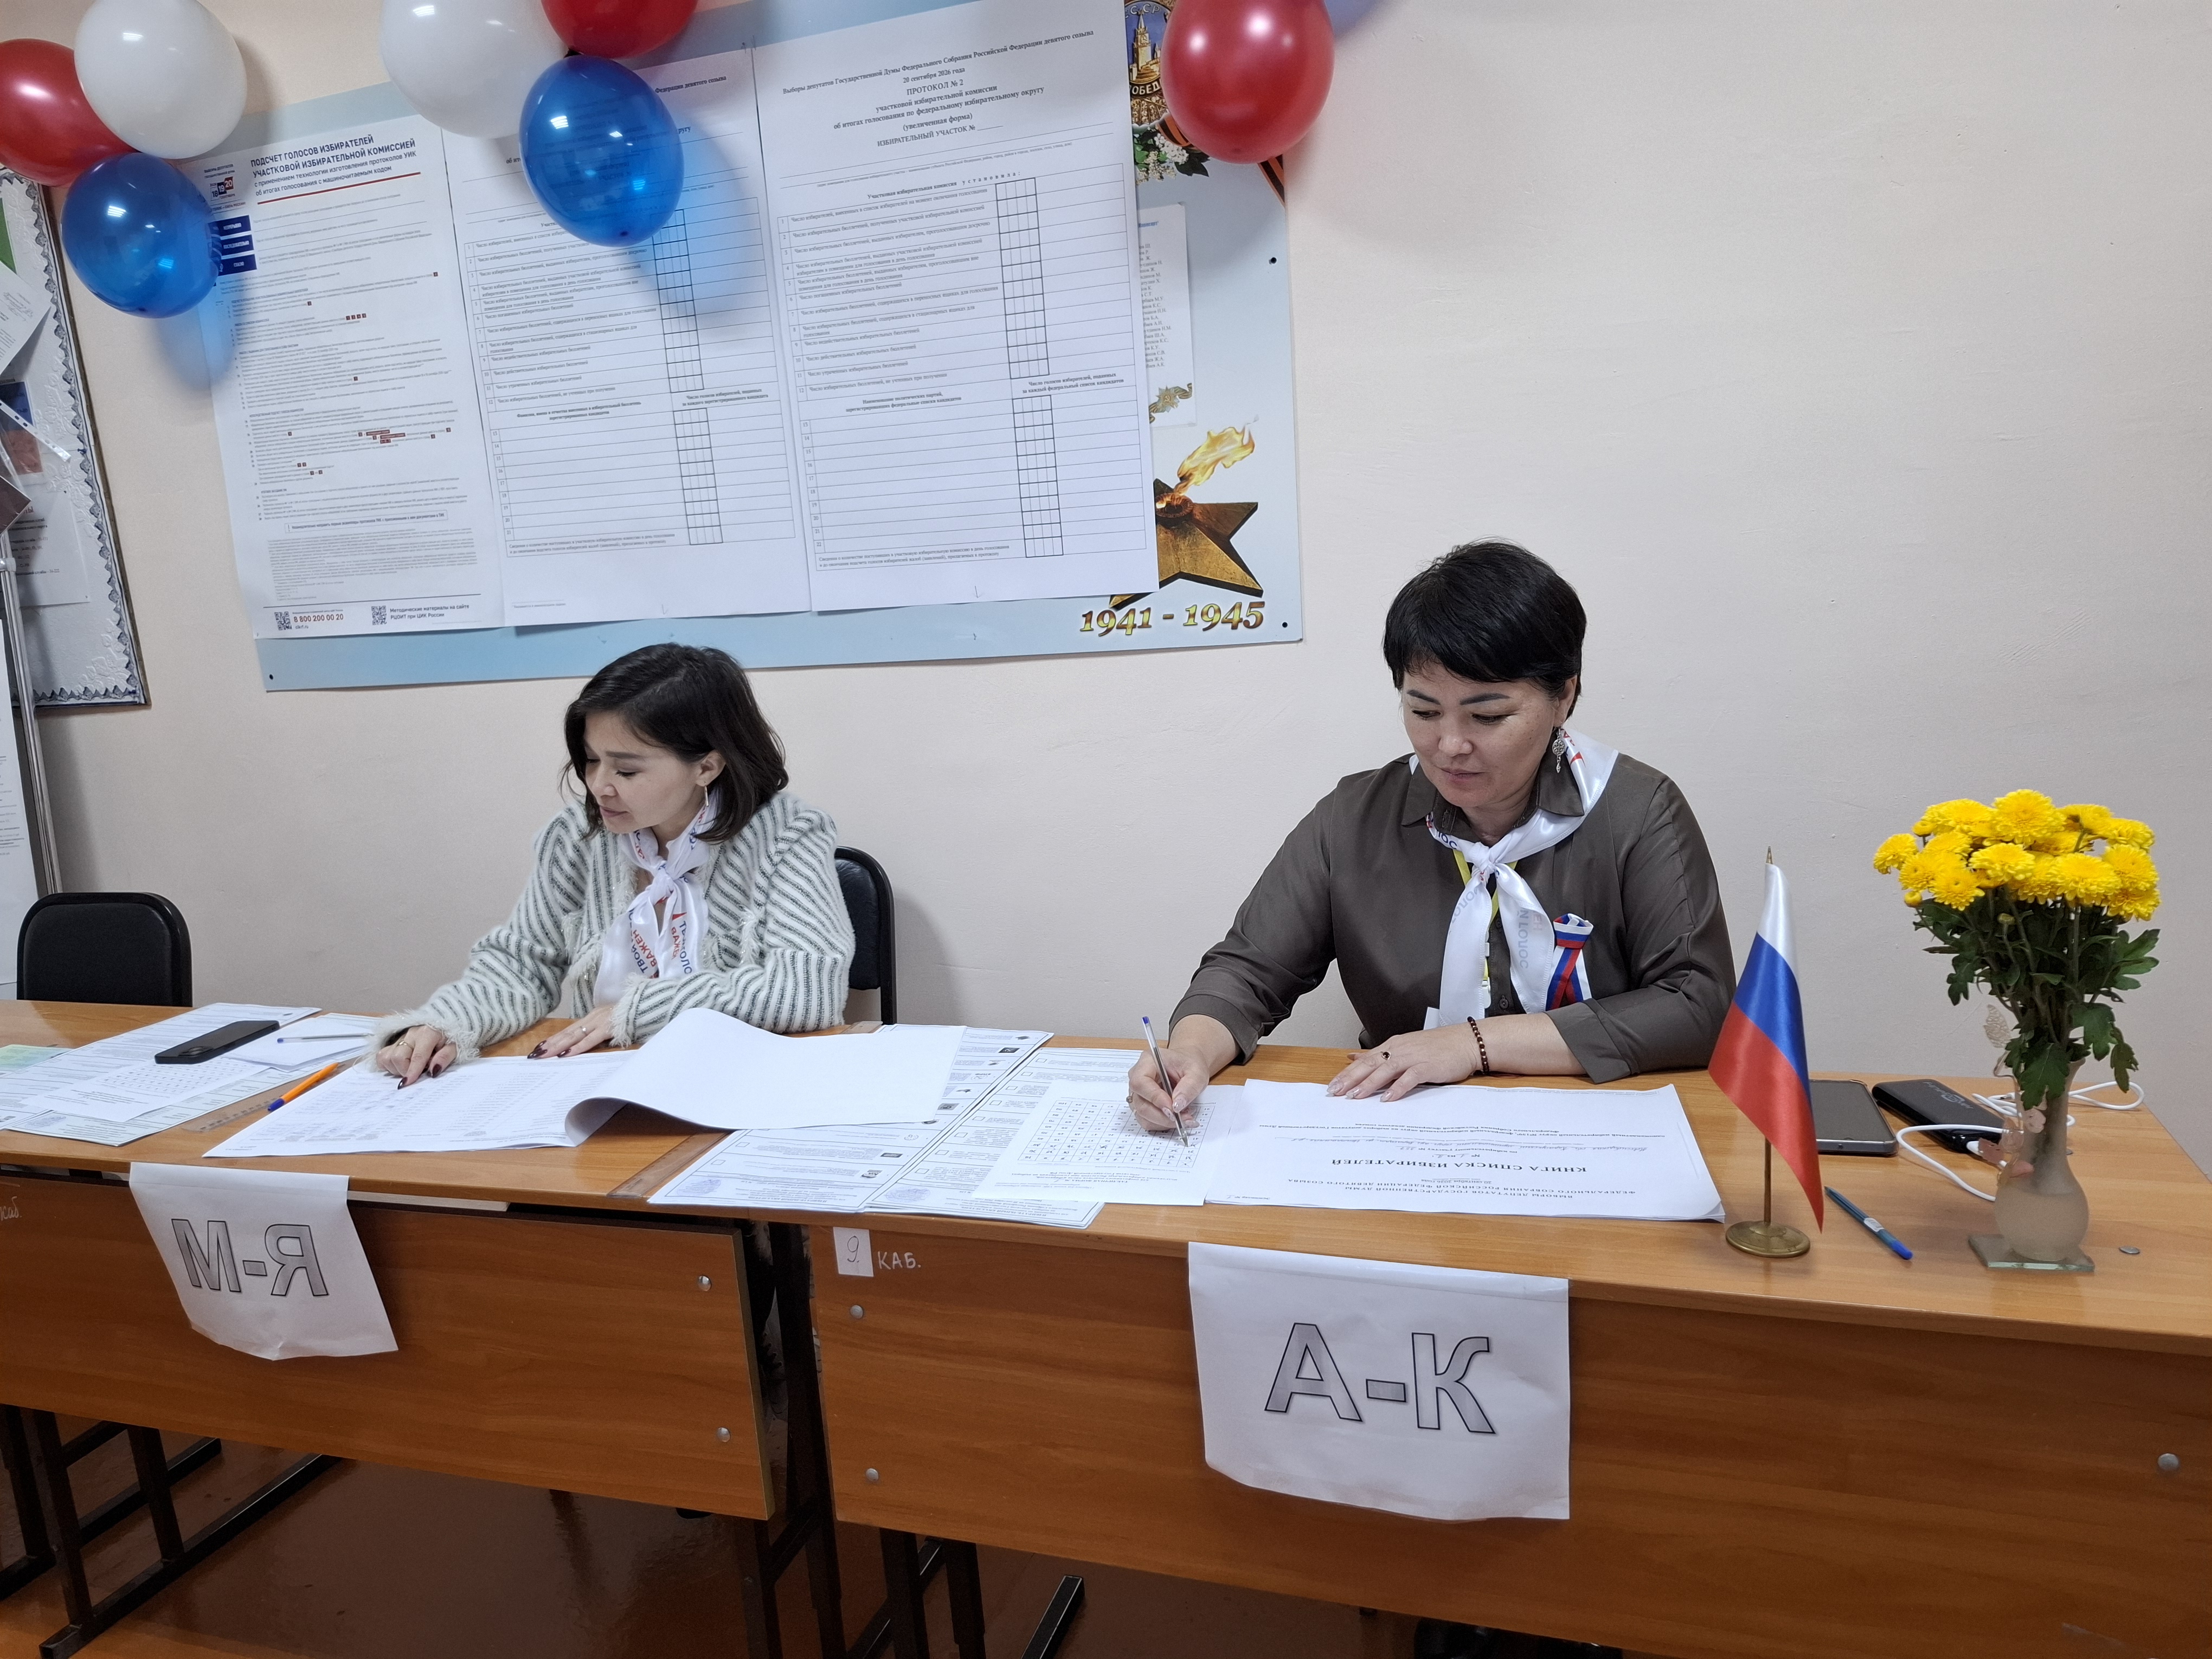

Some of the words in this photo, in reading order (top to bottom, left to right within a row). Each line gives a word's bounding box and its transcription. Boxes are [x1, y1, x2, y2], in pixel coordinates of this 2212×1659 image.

[782, 86, 806, 94] Выборы
[806, 81, 834, 91] депутатов
[834, 69, 883, 84] Государственной
[901, 60, 942, 71] Федерального
[943, 54, 972, 63] Собрания
[973, 45, 1008, 58] Российской
[1008, 40, 1043, 50] Федерации
[1044, 35, 1071, 45] девятого
[1072, 30, 1094, 39] созыва
[906, 81, 949, 95] ПРОТОКОЛ
[910, 73, 937, 82] сентября
[842, 120, 864, 128] итогах
[864, 112, 905, 124] голосования
[916, 101, 963, 116] федеральному
[964, 92, 1019, 106] избирательному
[1021, 87, 1044, 96] округу
[876, 99, 913, 113] участковой
[914, 92, 963, 105] избирательной
[964, 86, 998, 96] комиссии
[877, 130, 934, 146] ИЗБИРАТЕЛЬНЫЙ
[935, 125, 968, 137] УЧАСТОК
[903, 118, 947, 131] (увеличенная
[948, 112, 973, 124] форма)
[250, 153, 282, 167] ПОДСЧЕТ
[284, 147, 319, 160] ГОЛОСОВ
[319, 136, 374, 153] ИЗБИРАТЕЛЕЙ
[253, 160, 300, 178] УЧАСТКОВОЙ
[301, 147, 366, 169] ИЗБИРАТЕЛЬНОЙ
[367, 138, 415, 156] КОМИССИЕЙ
[258, 175, 295, 187] применением
[295, 169, 329, 179] технологии
[329, 161, 368, 173] изготовления
[369, 154, 403, 166] протоколов
[403, 150, 416, 158] УИК
[281, 180, 318, 191] голосования
[323, 169, 373, 183] машиночитаемым
[373, 165, 392, 173] кодом
[1080, 607, 1152, 636] 1941
[1182, 601, 1265, 631] 1945
[632, 944, 648, 973] ТВОЙ
[633, 929, 657, 967] ВАЖЕН
[1332, 1159, 1447, 1168] ИЗБИРАТЕЛЕЙ
[171, 1218, 329, 1296] М-Я
[878, 1251, 921, 1270] КАБ.
[1263, 1321, 1496, 1436] А-К
